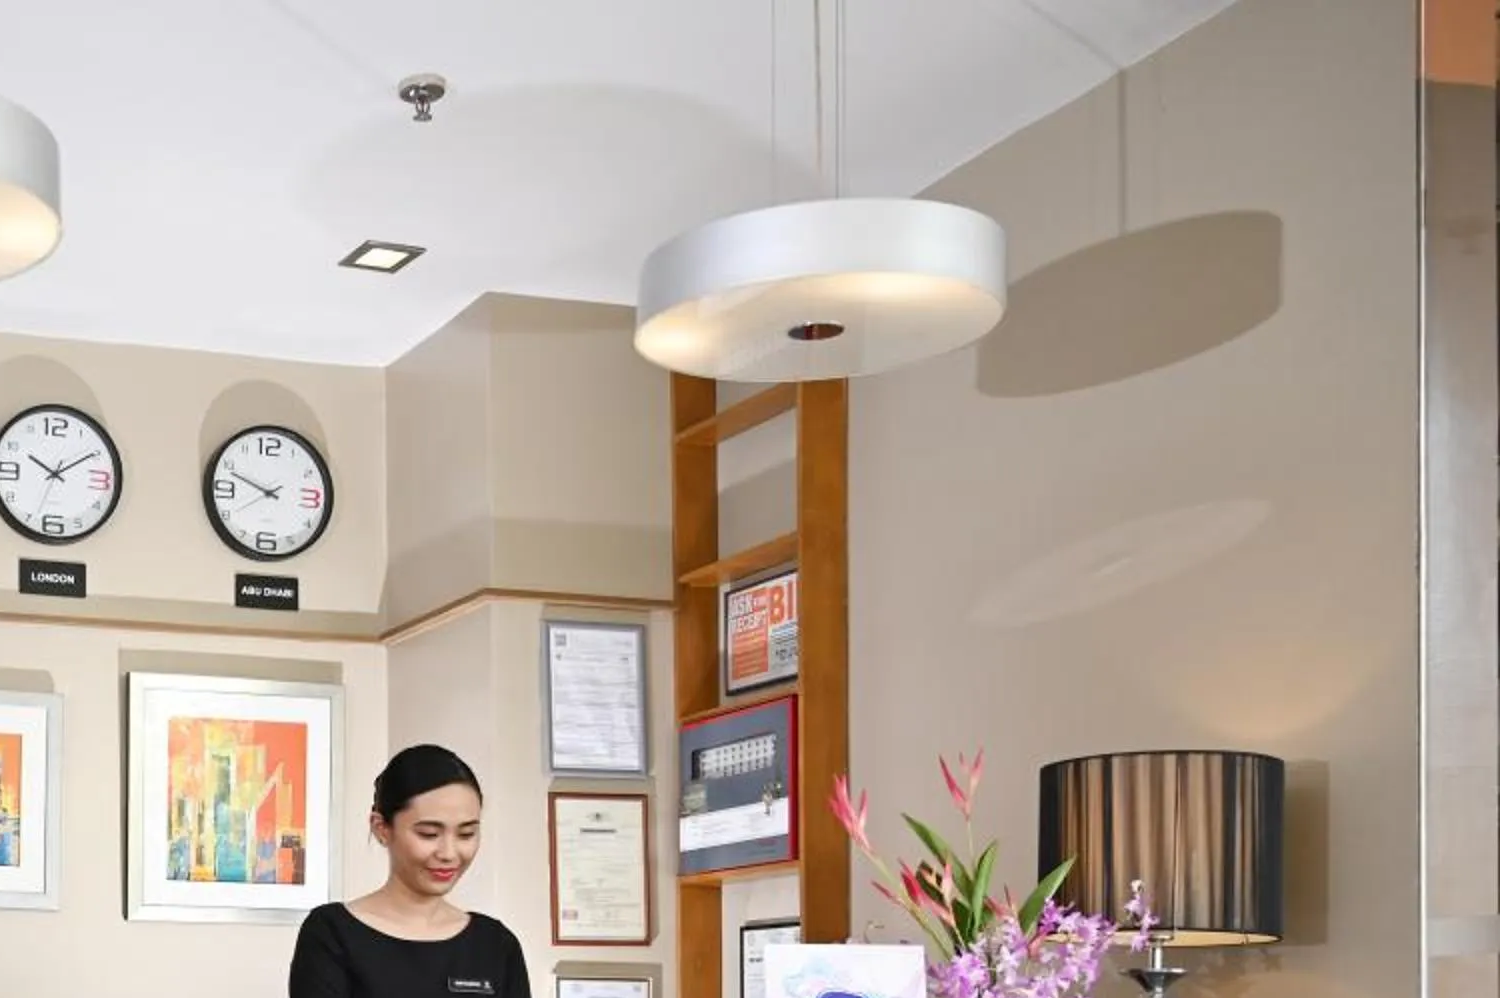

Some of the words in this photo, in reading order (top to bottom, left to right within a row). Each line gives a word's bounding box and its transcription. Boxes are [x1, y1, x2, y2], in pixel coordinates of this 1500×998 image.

[43, 416, 69, 438] 12
[258, 436, 281, 457] 12
[87, 469, 110, 491] 3
[215, 479, 235, 499] 9
[298, 487, 320, 509] 3
[41, 515, 64, 534] 6
[255, 531, 277, 551] 6
[30, 571, 76, 585] LONDON
[241, 585, 262, 596] ABU
[264, 587, 294, 599] DHABI
[767, 579, 796, 625] BI
